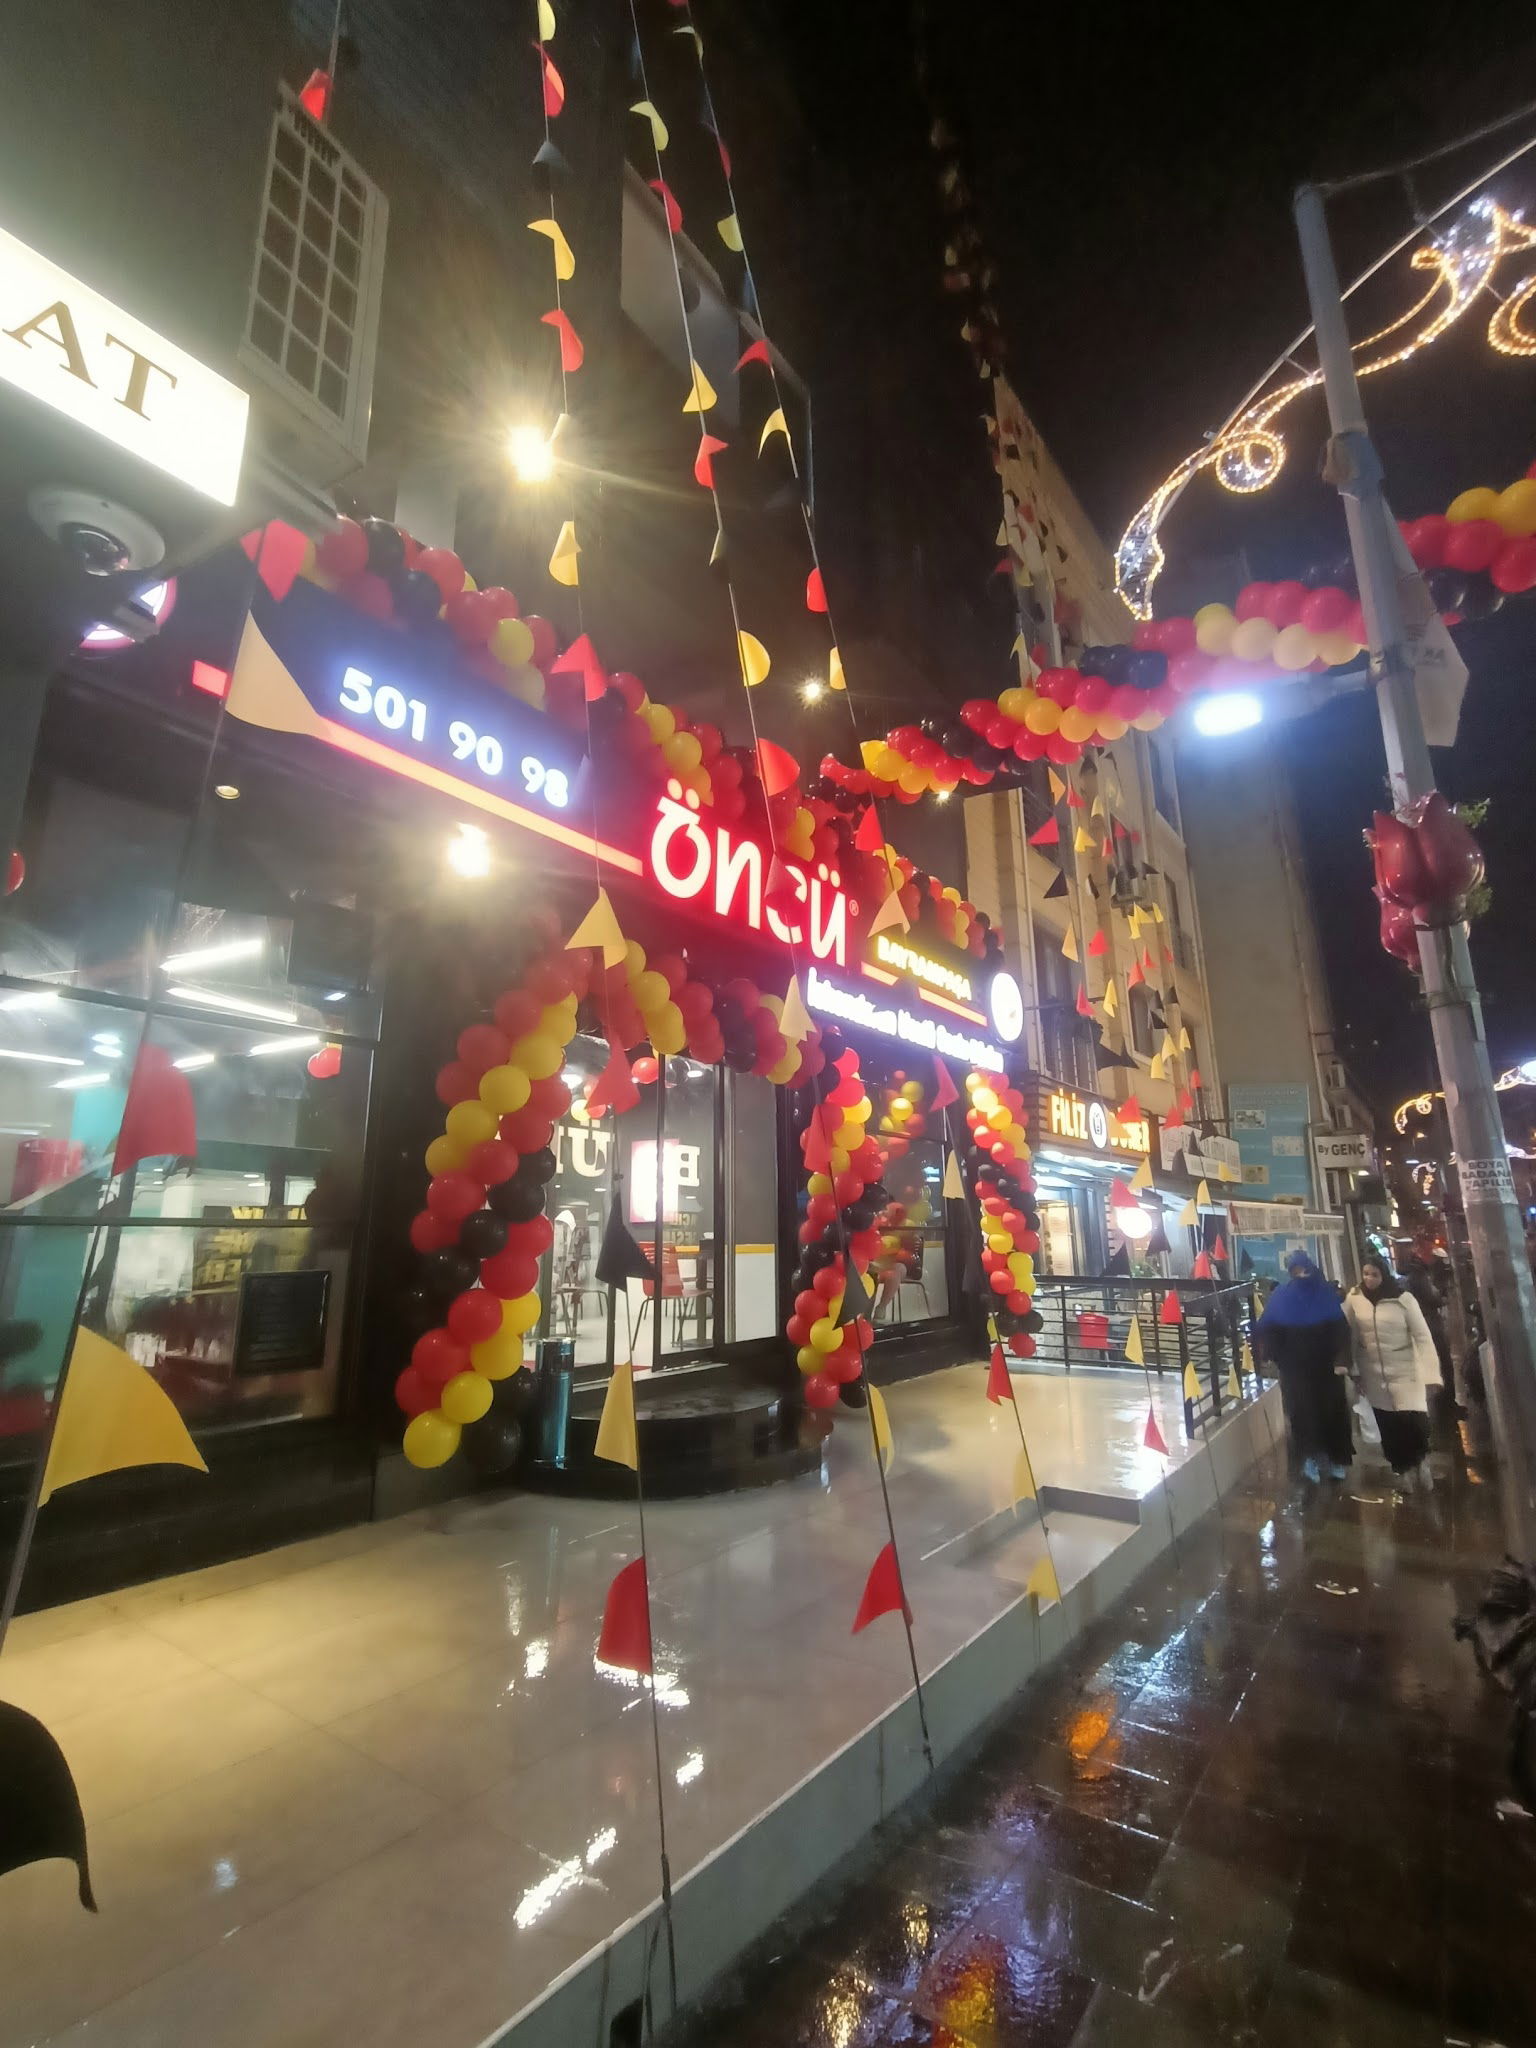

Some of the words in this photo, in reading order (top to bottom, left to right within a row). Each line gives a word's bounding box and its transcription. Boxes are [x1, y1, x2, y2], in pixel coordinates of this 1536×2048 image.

[339, 666, 428, 742] 501
[449, 720, 504, 776] 90
[520, 756, 569, 808] 98
[1051, 1087, 1089, 1140] FİLİZ
[1317, 1144, 1329, 1156] By
[1331, 1142, 1366, 1158] GENÇ
